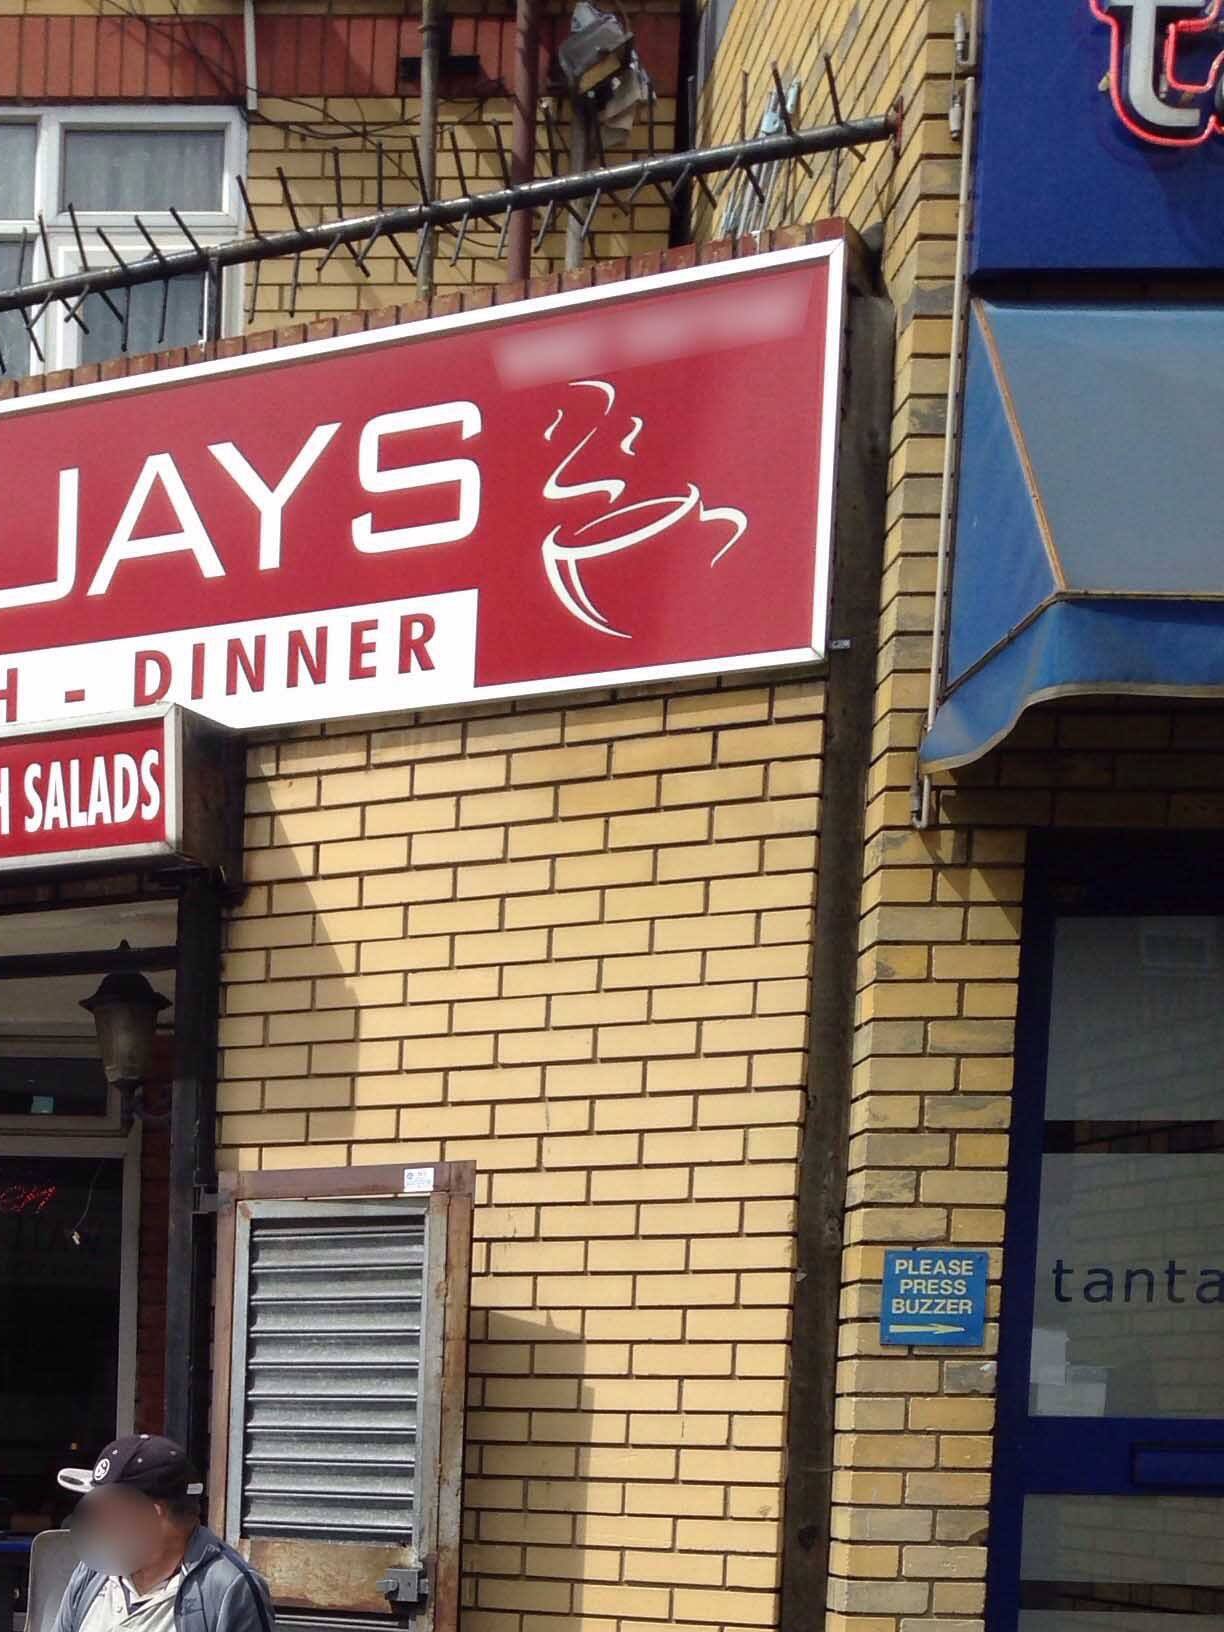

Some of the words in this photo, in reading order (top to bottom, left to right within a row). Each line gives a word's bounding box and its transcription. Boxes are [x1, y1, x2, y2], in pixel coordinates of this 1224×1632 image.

[133, 612, 437, 708] DINNER
[23, 749, 161, 833] SALADS
[895, 1258, 974, 1277] PLEASE
[899, 1279, 967, 1295] PRESS
[891, 1298, 973, 1315] BUZZER
